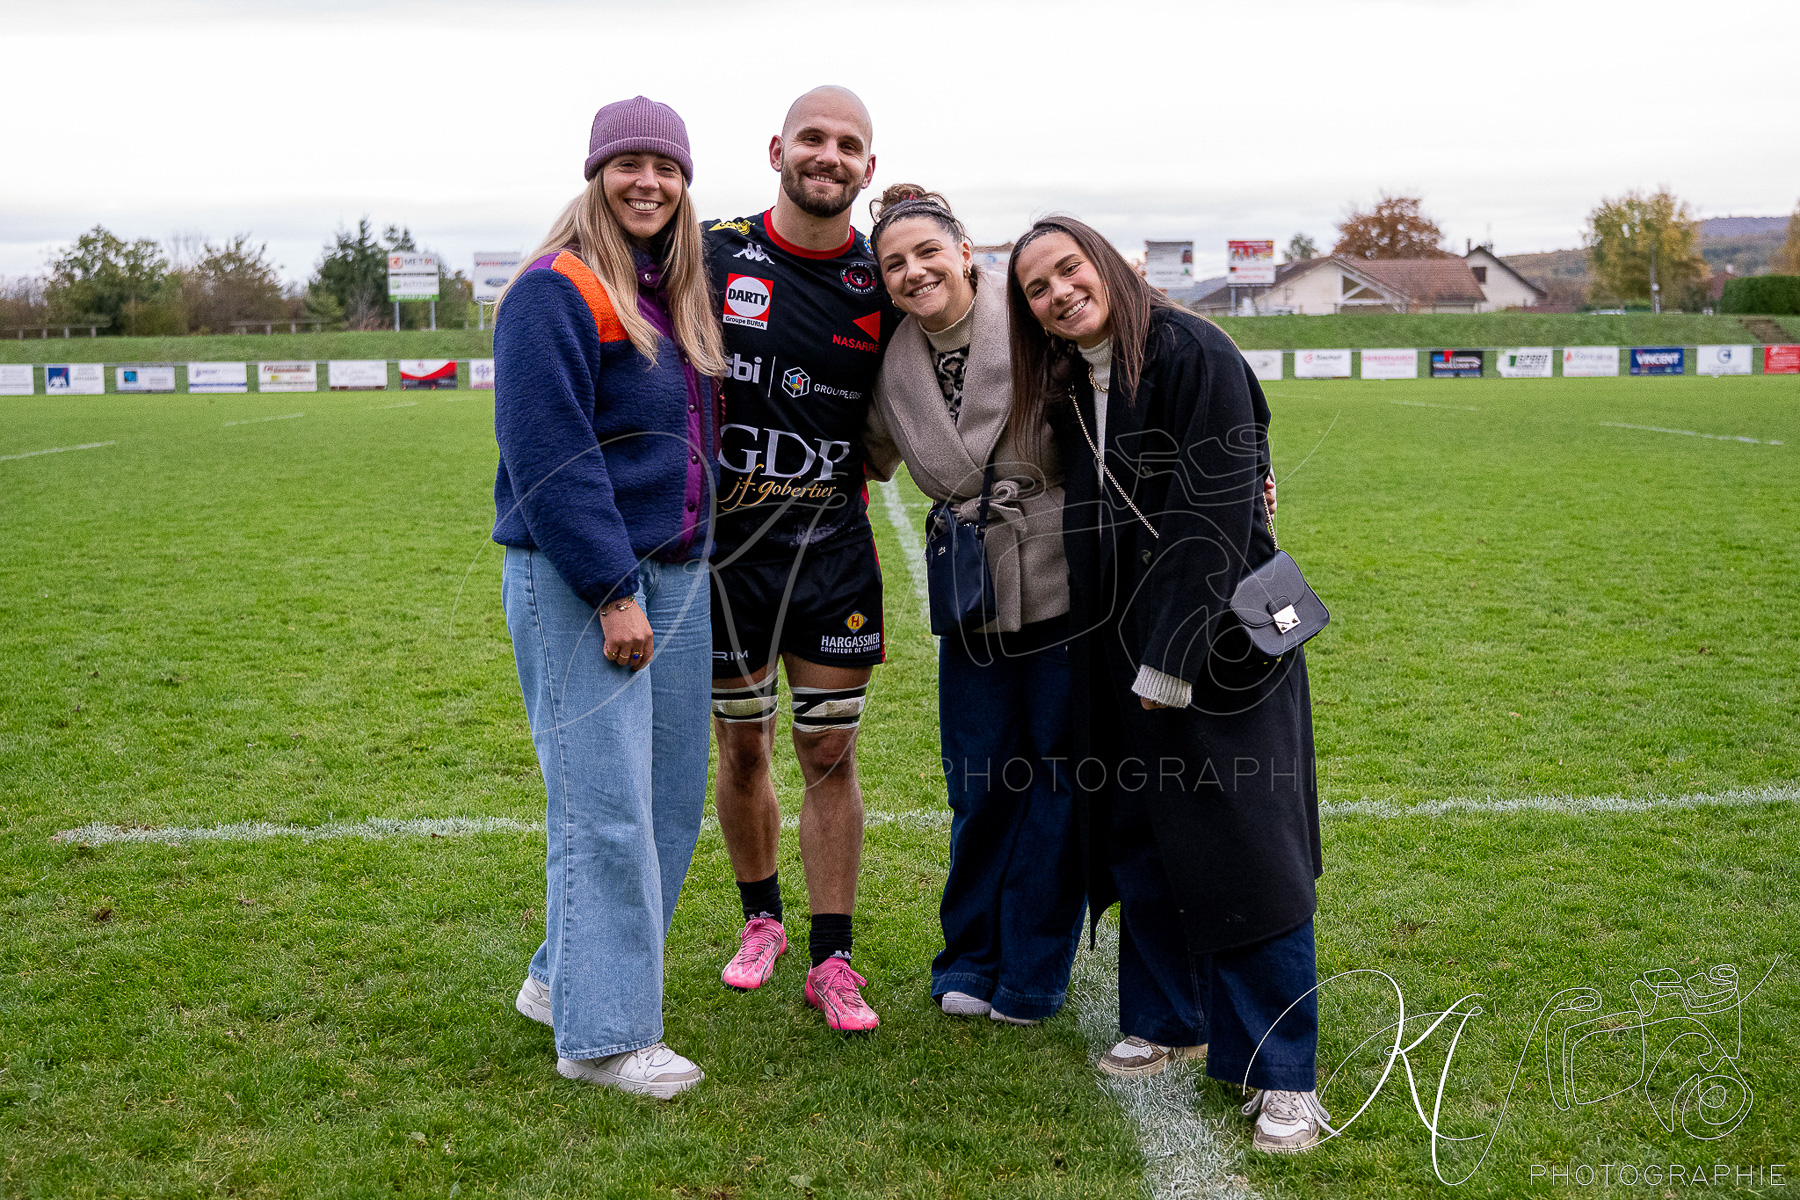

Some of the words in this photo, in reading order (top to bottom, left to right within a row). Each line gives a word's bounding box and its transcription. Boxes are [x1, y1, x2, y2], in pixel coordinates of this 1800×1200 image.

[727, 287, 769, 307] DARTY
[725, 315, 746, 324] Groupe
[832, 334, 880, 354] NASARRE
[1635, 352, 1681, 365] VINCENT
[851, 615, 860, 627] H
[821, 632, 881, 648] HARGASSNER
